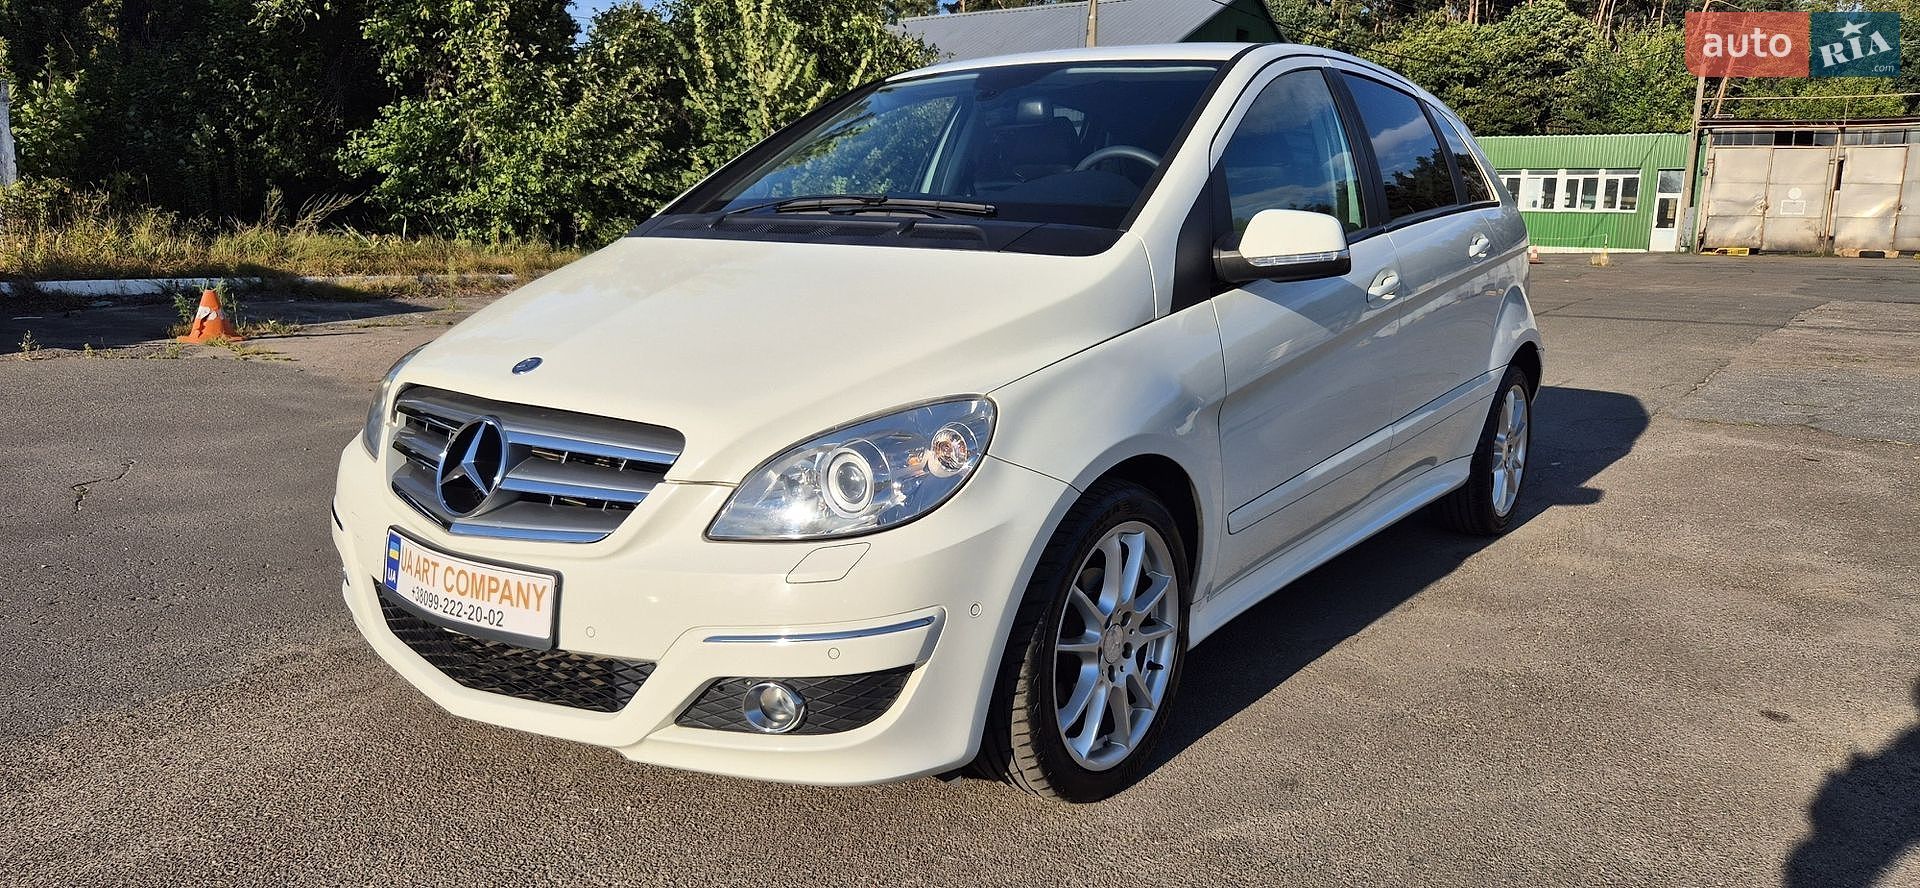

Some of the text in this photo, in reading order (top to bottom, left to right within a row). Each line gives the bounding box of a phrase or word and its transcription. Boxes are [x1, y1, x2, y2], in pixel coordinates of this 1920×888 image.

[387, 567, 397, 583] UA
[414, 556, 440, 587] ART
[443, 566, 547, 612] COMPANY
[412, 586, 504, 627] +38099-222-20-02
